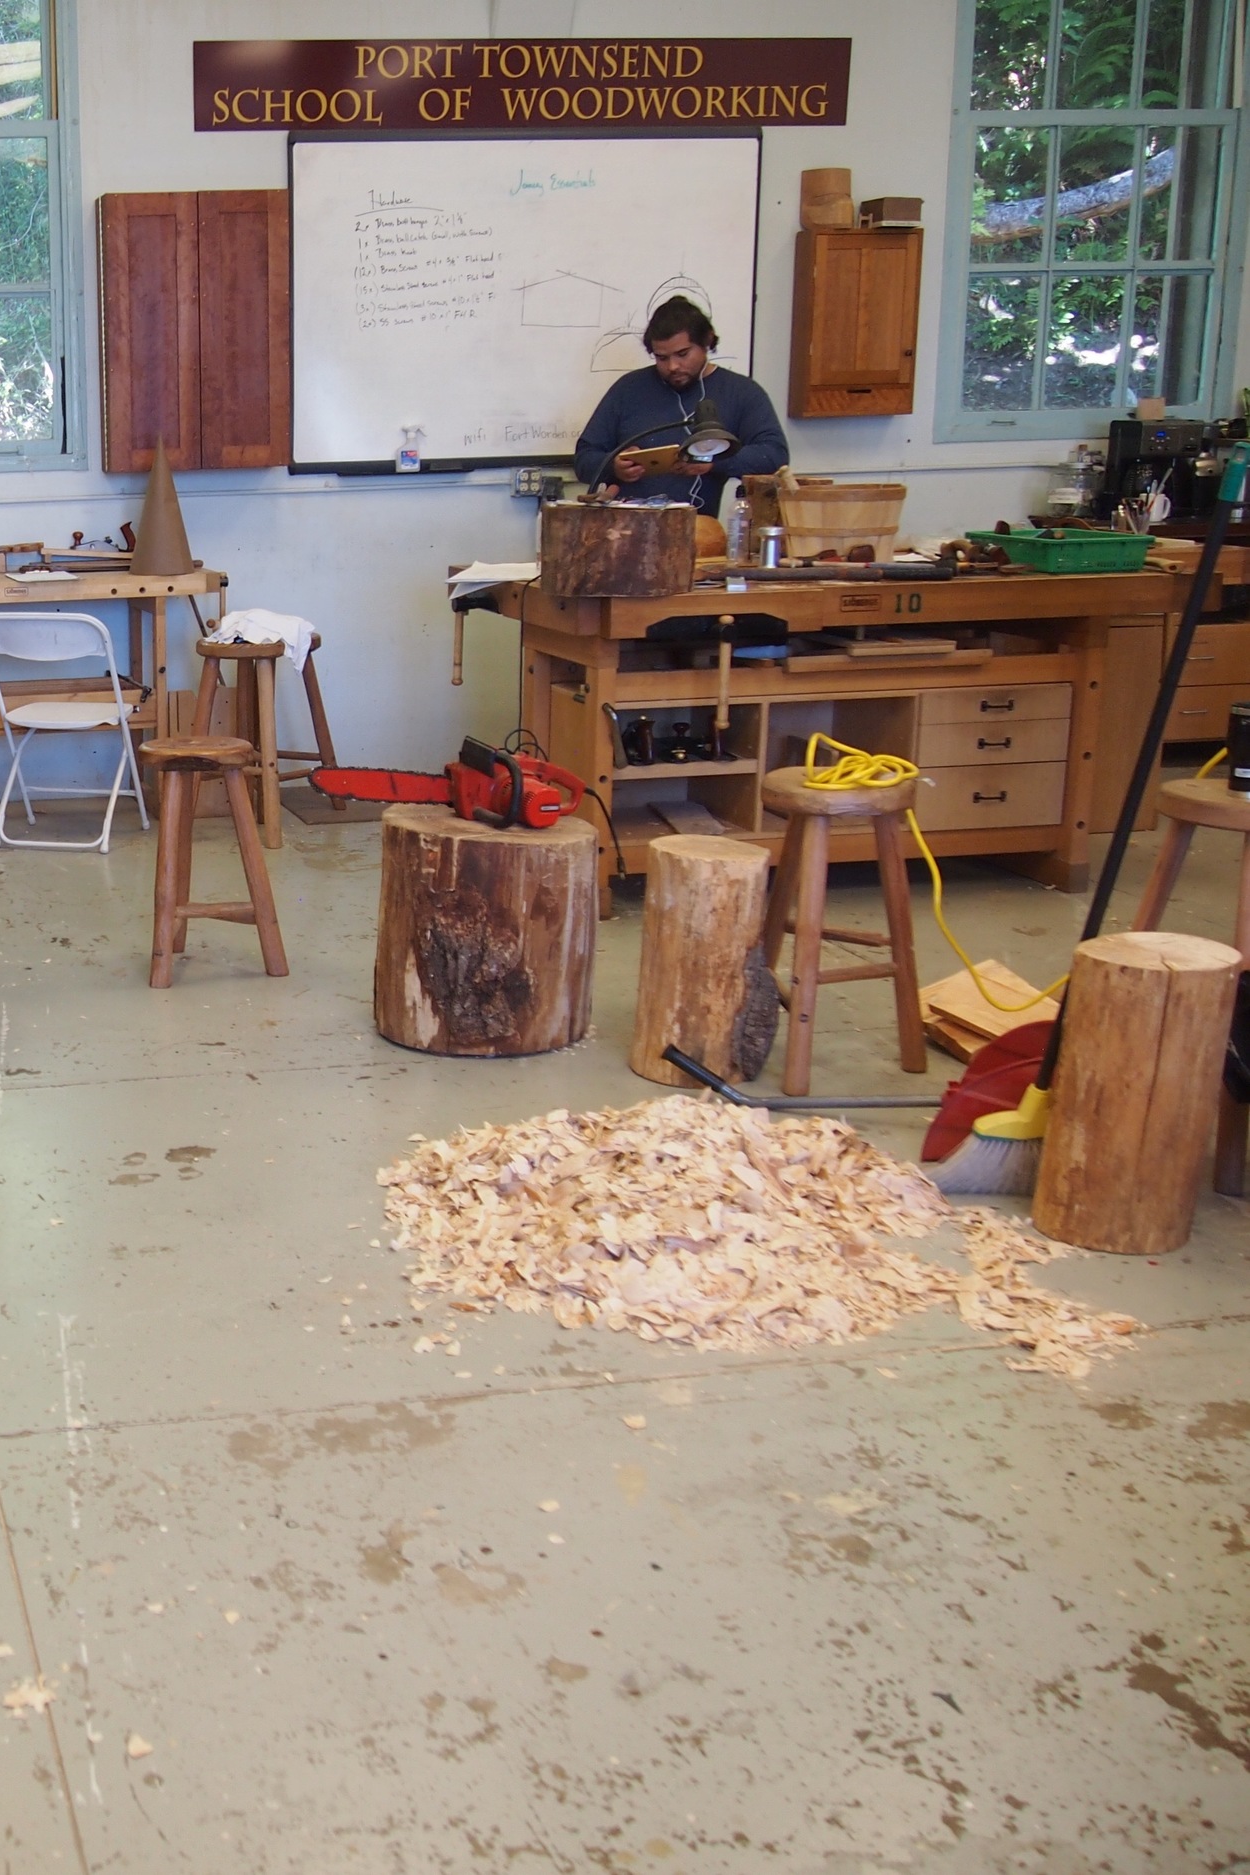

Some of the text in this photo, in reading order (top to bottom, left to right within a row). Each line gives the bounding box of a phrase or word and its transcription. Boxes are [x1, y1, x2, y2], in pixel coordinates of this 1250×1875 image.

[353, 42, 704, 79] PORT TOWNSEND
[211, 83, 829, 126] SCHOOL OF WOODWORKING
[368, 189, 414, 210] Hardware
[504, 425, 530, 442] Fort
[532, 425, 568, 440] Worden
[894, 592, 922, 613] 10
